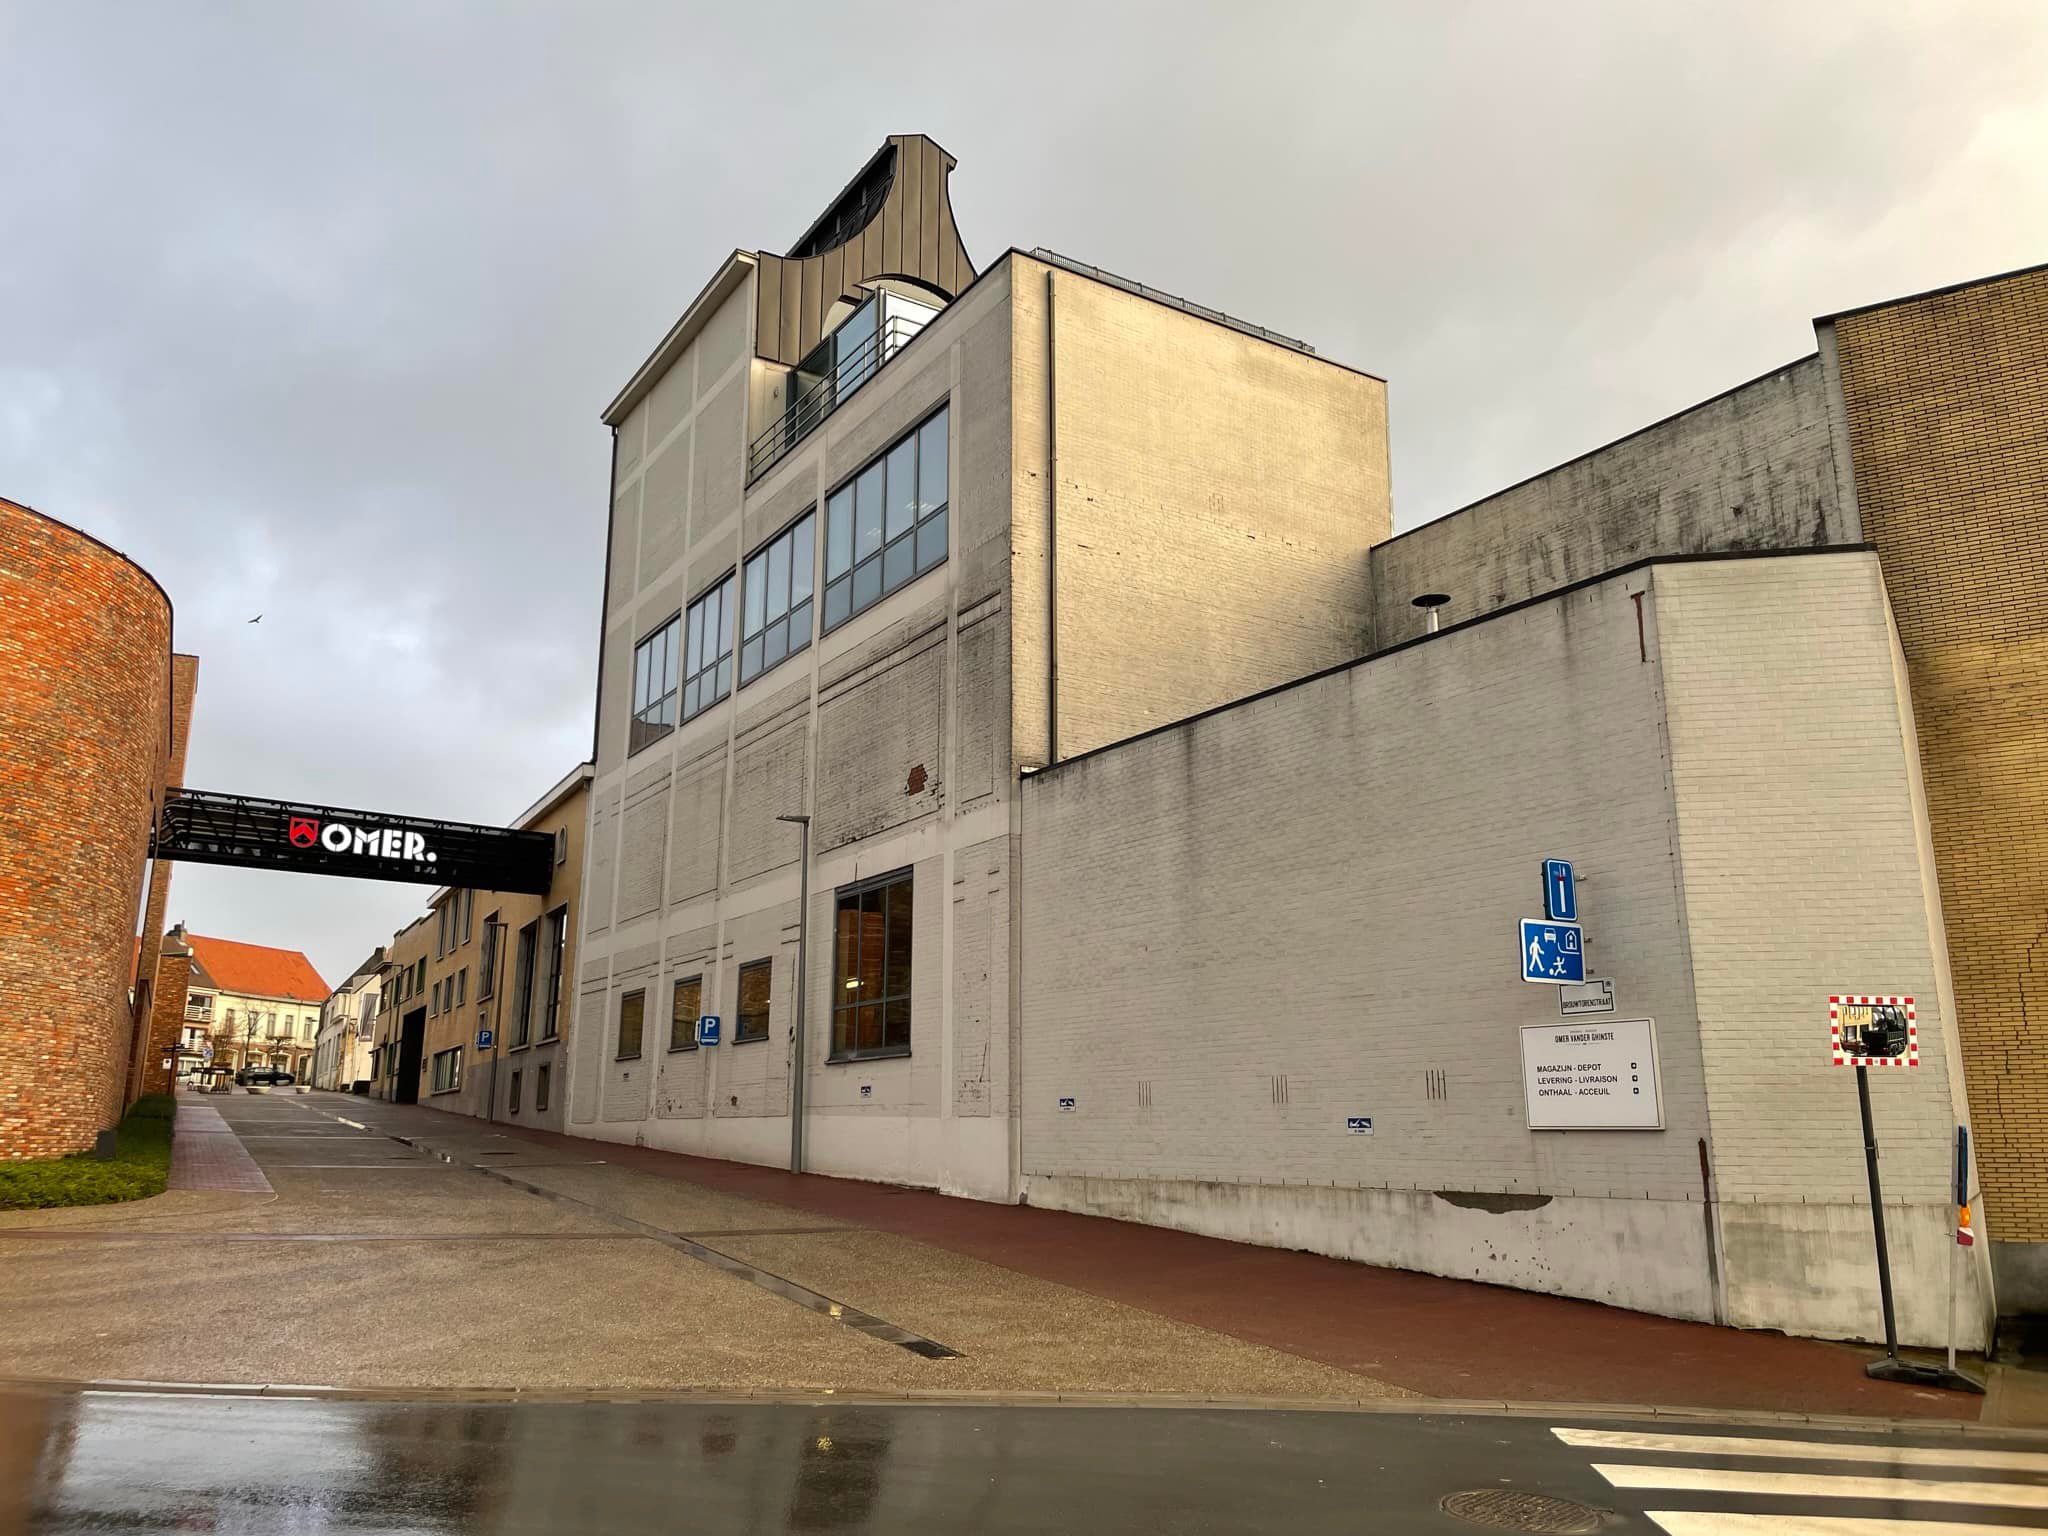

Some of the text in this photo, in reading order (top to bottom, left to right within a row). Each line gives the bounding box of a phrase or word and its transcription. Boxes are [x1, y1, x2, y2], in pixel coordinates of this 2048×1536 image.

[321, 823, 437, 862] OMER.
[705, 1018, 715, 1034] P
[481, 1031, 490, 1042] P
[1555, 1034, 1569, 1043] OMER
[1570, 1033, 1590, 1042] VANDER
[1591, 1031, 1614, 1041] GHINSTE
[1577, 1063, 1601, 1071] DEPOT
[1538, 1076, 1573, 1084] LEVERING
[1578, 1075, 1617, 1083] LIVRAISON
[1578, 1087, 1610, 1095] ACCEUIL
